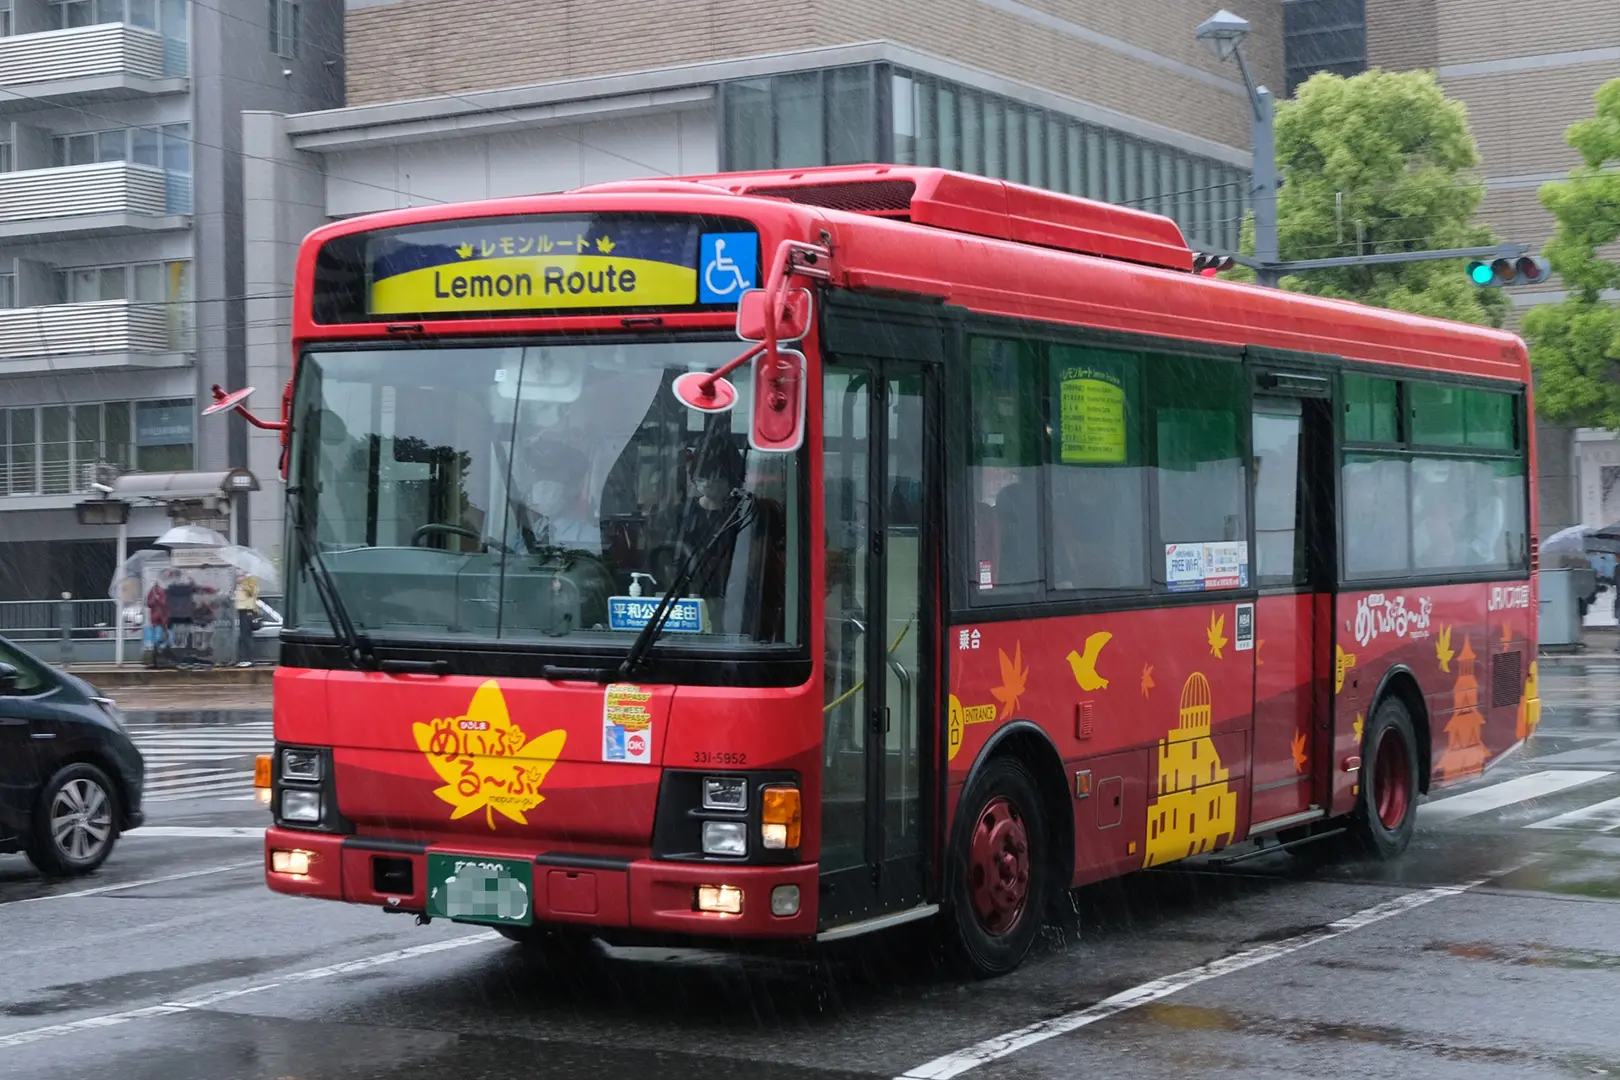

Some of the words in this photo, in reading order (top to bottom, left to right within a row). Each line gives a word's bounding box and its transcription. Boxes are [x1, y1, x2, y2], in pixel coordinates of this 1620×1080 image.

[481, 234, 591, 257] レモンルート
[434, 269, 532, 300] Lemon
[543, 263, 637, 295] Route
[613, 603, 697, 620] 平和公経由
[959, 629, 981, 650] 乗合
[965, 706, 994, 722] ENTRANCE
[950, 710, 960, 745] 入口
[693, 752, 747, 764] 331-5952
